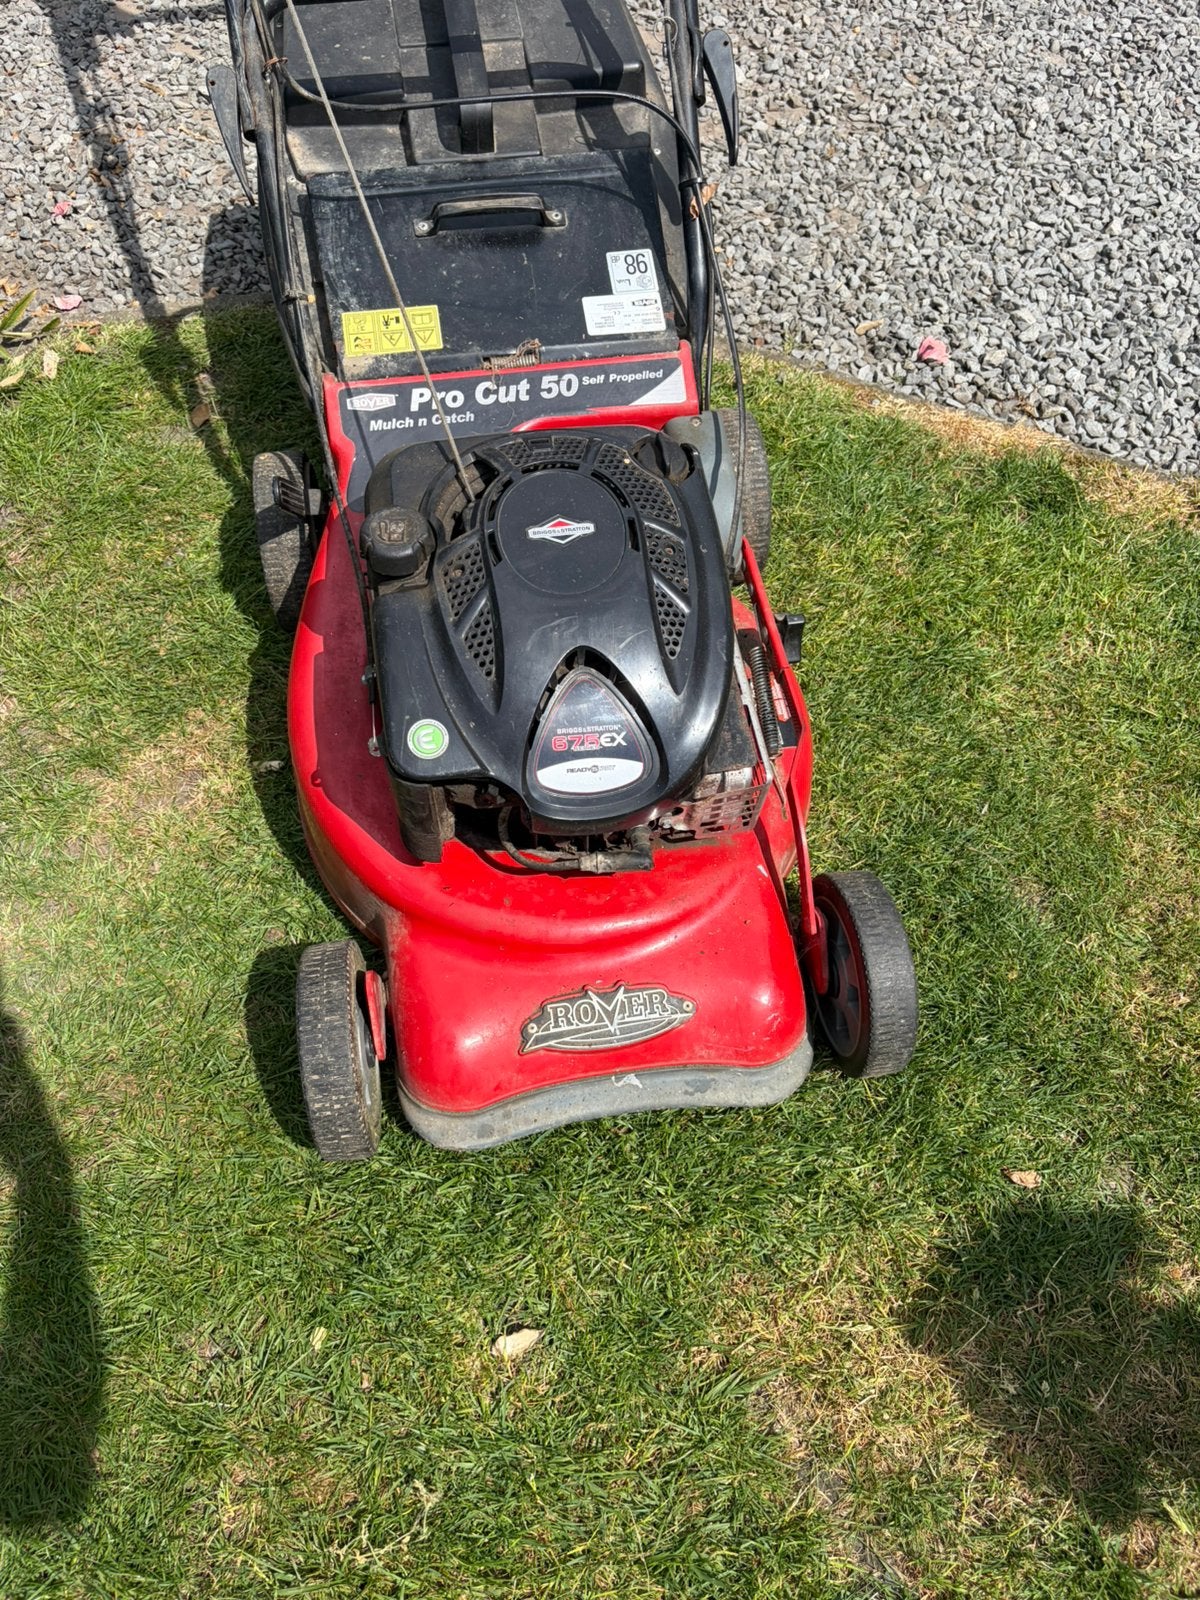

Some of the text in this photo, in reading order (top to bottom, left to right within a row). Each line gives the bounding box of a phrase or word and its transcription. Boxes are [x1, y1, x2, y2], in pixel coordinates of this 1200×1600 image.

[352, 396, 390, 409] ROVER
[410, 369, 663, 412] Pro Cut 50 Self Propelled
[369, 416, 414, 431] Mulch
[418, 418, 427, 426] n
[547, 985, 671, 1033] ROVER
